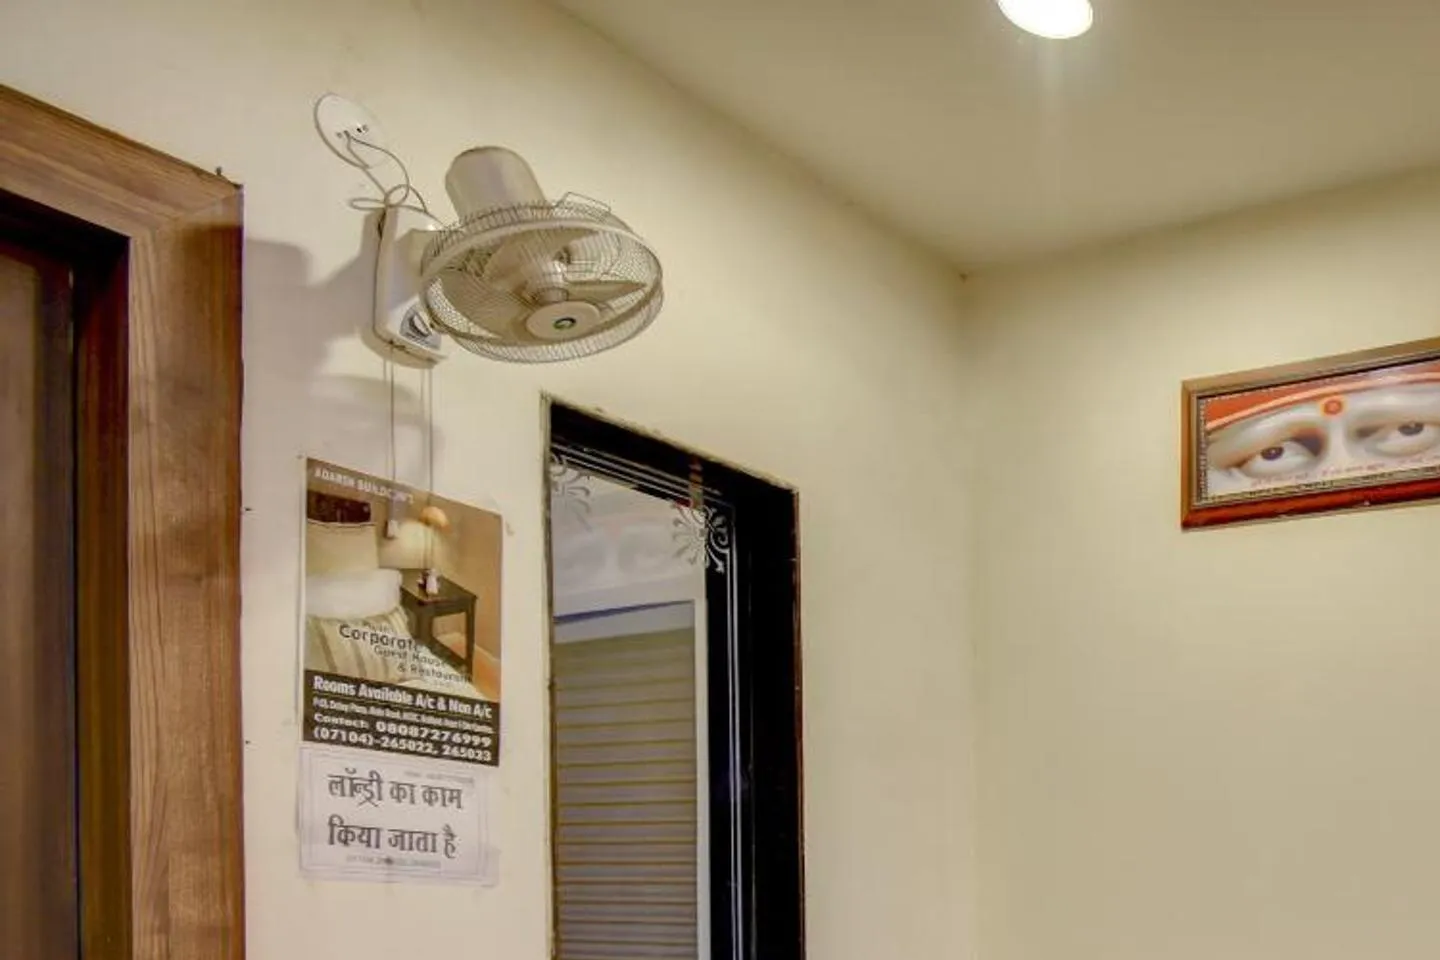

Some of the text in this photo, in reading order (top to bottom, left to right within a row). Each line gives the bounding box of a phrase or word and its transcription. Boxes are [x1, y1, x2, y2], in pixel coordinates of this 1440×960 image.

[339, 624, 422, 652] Corporate
[374, 645, 408, 662] Guest
[313, 675, 356, 696] Rooms
[358, 683, 413, 705] Available
[437, 695, 447, 711] &
[449, 698, 472, 714] Non
[375, 721, 492, 748] 08087276999
[442, 744, 492, 761] 265023
[389, 780, 416, 805] का
[421, 784, 463, 809] काम
[327, 814, 458, 859] किया जाता है
